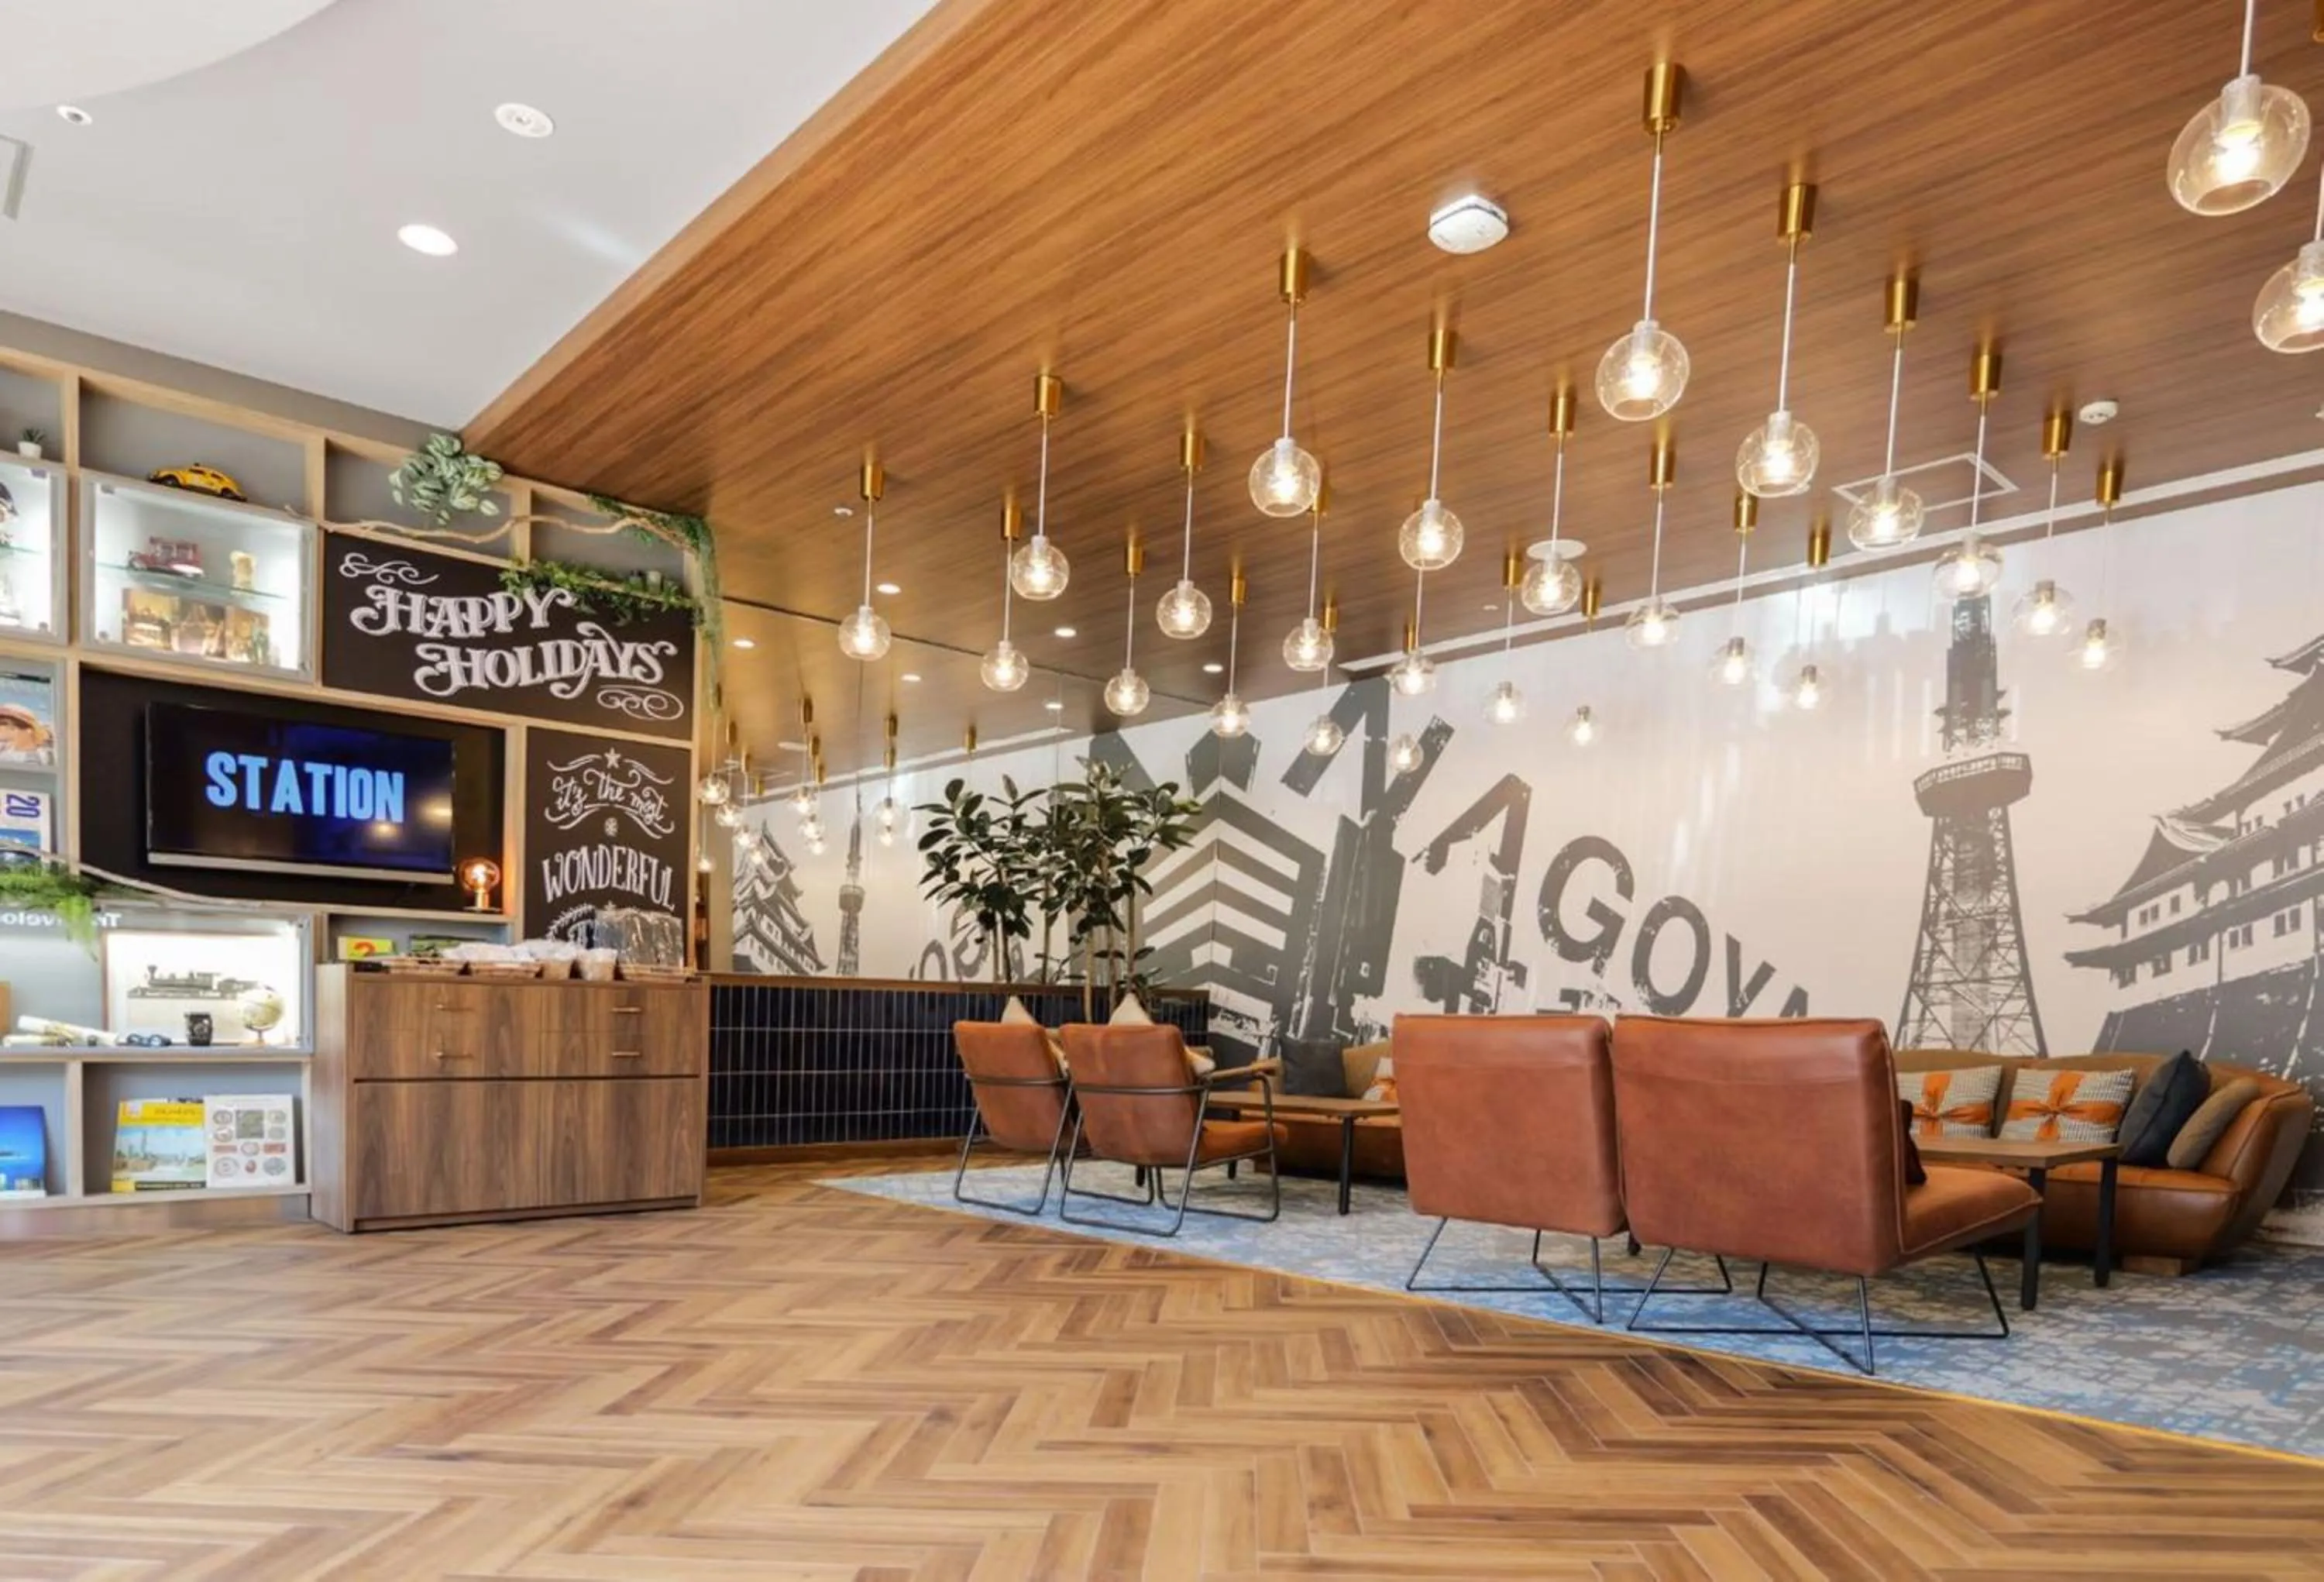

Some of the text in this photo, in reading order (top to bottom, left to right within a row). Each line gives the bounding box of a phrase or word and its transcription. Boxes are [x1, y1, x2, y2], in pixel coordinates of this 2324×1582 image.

[349, 585, 578, 638] HAPPY
[414, 622, 678, 698] HOLIDAYS
[205, 751, 404, 824] STATION
[542, 844, 676, 912] WONDERFUL
